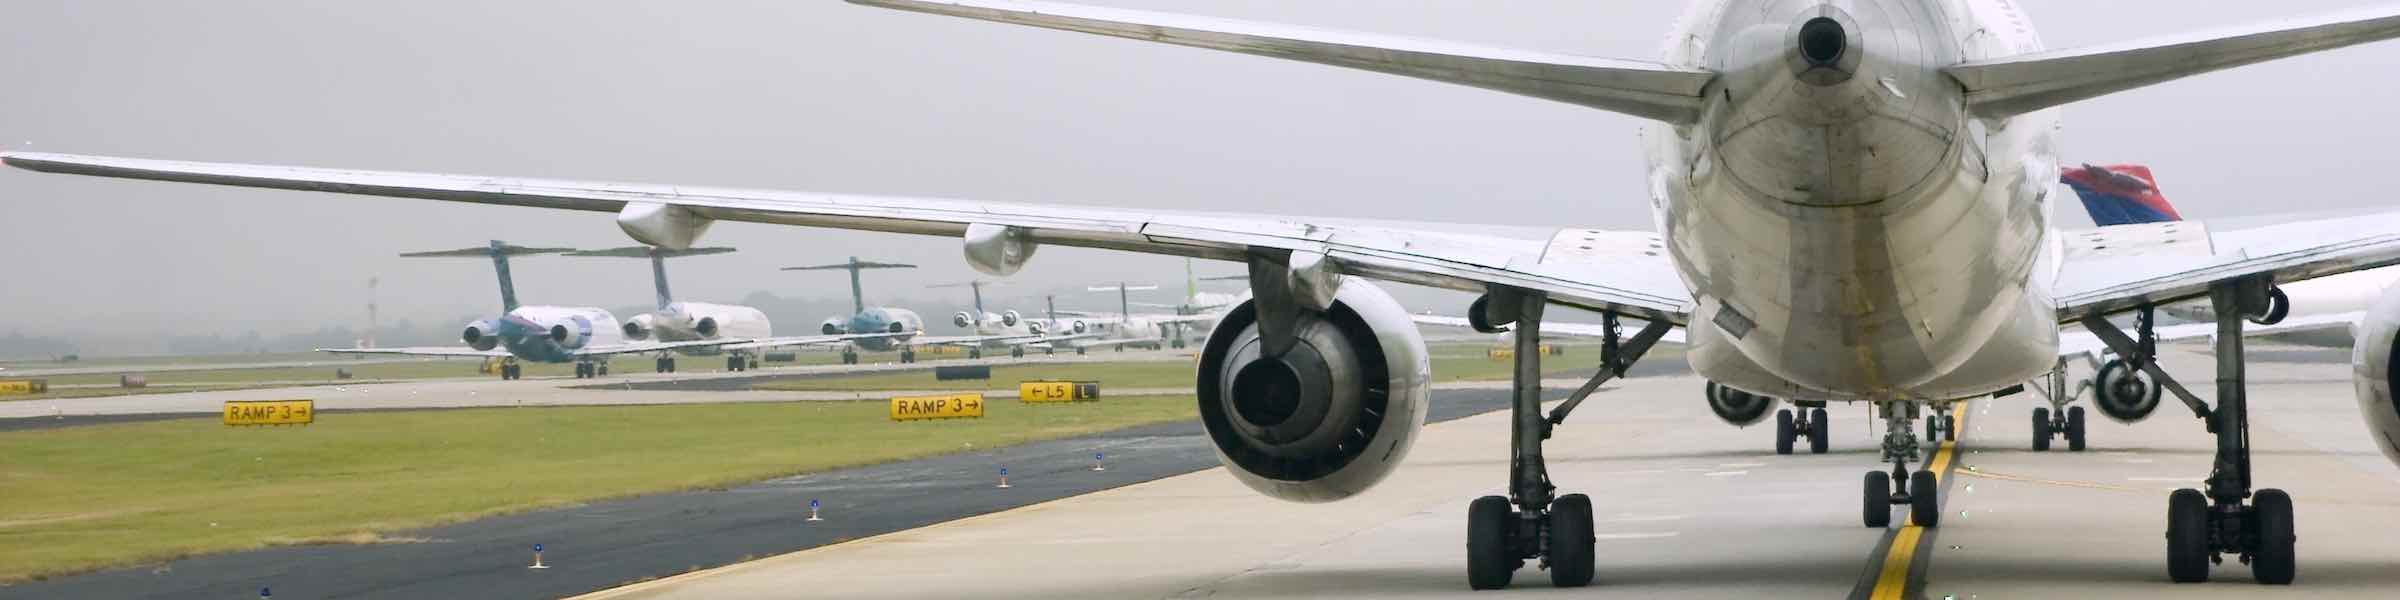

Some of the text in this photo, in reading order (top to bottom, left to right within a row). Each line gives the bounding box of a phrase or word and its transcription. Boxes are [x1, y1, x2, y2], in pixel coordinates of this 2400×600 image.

[1047, 384, 1089, 399] L5 L
[231, 405, 291, 420] RAMP 3
[898, 398, 962, 415] RAMP 3
